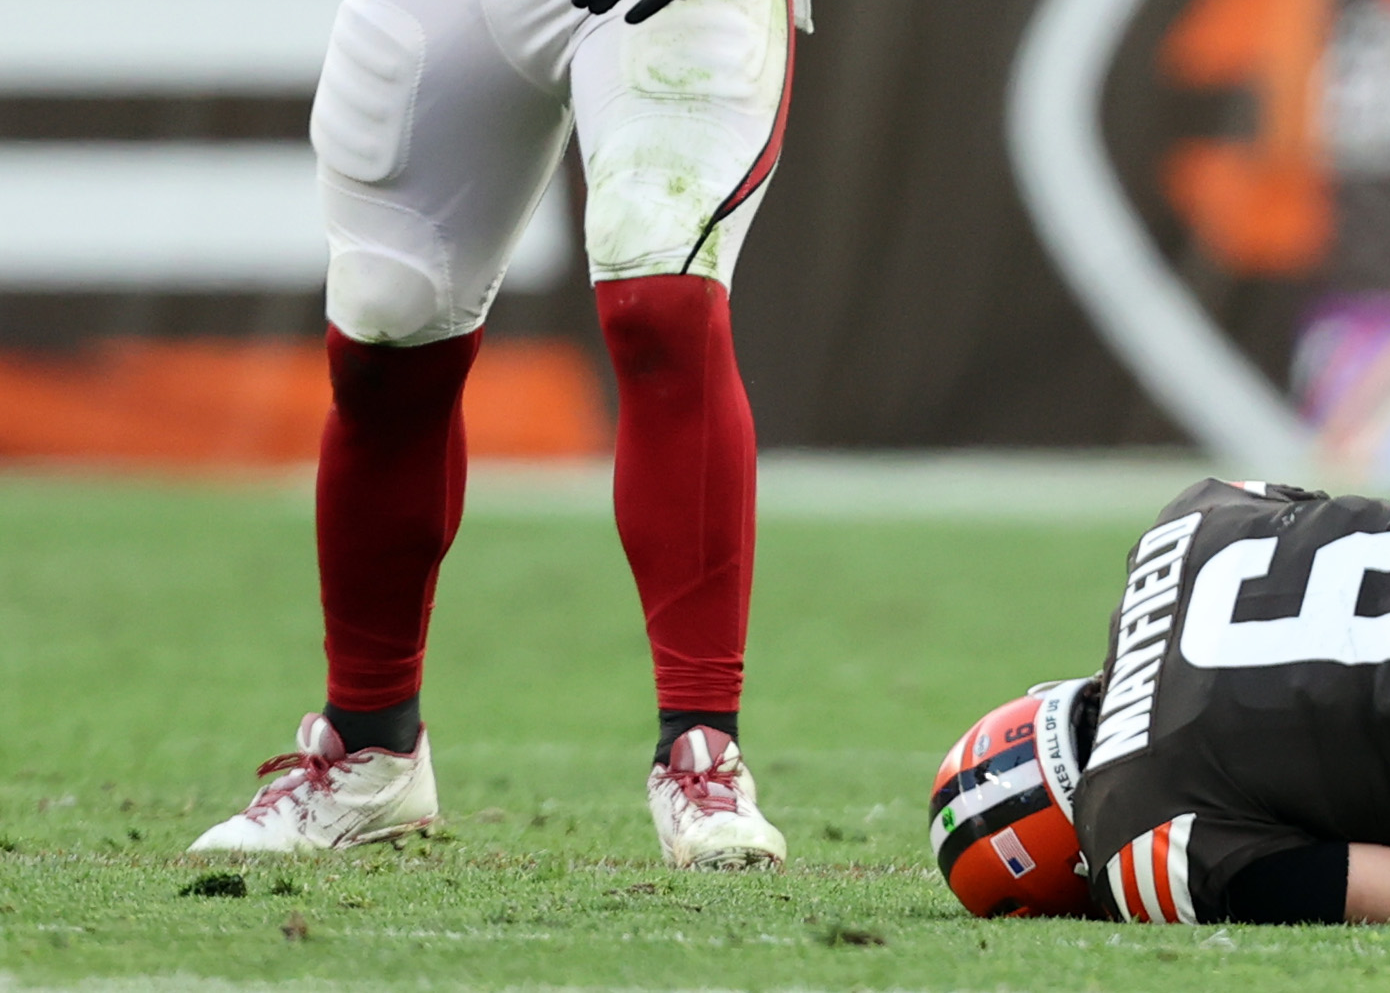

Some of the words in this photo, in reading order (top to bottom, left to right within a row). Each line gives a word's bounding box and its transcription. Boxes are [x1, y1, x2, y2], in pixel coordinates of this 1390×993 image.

[1086, 511, 1203, 772] MAYFIELD
[1004, 721, 1035, 744] 6
[1045, 714, 1057, 731] OF
[1047, 733, 1063, 759] ALL
